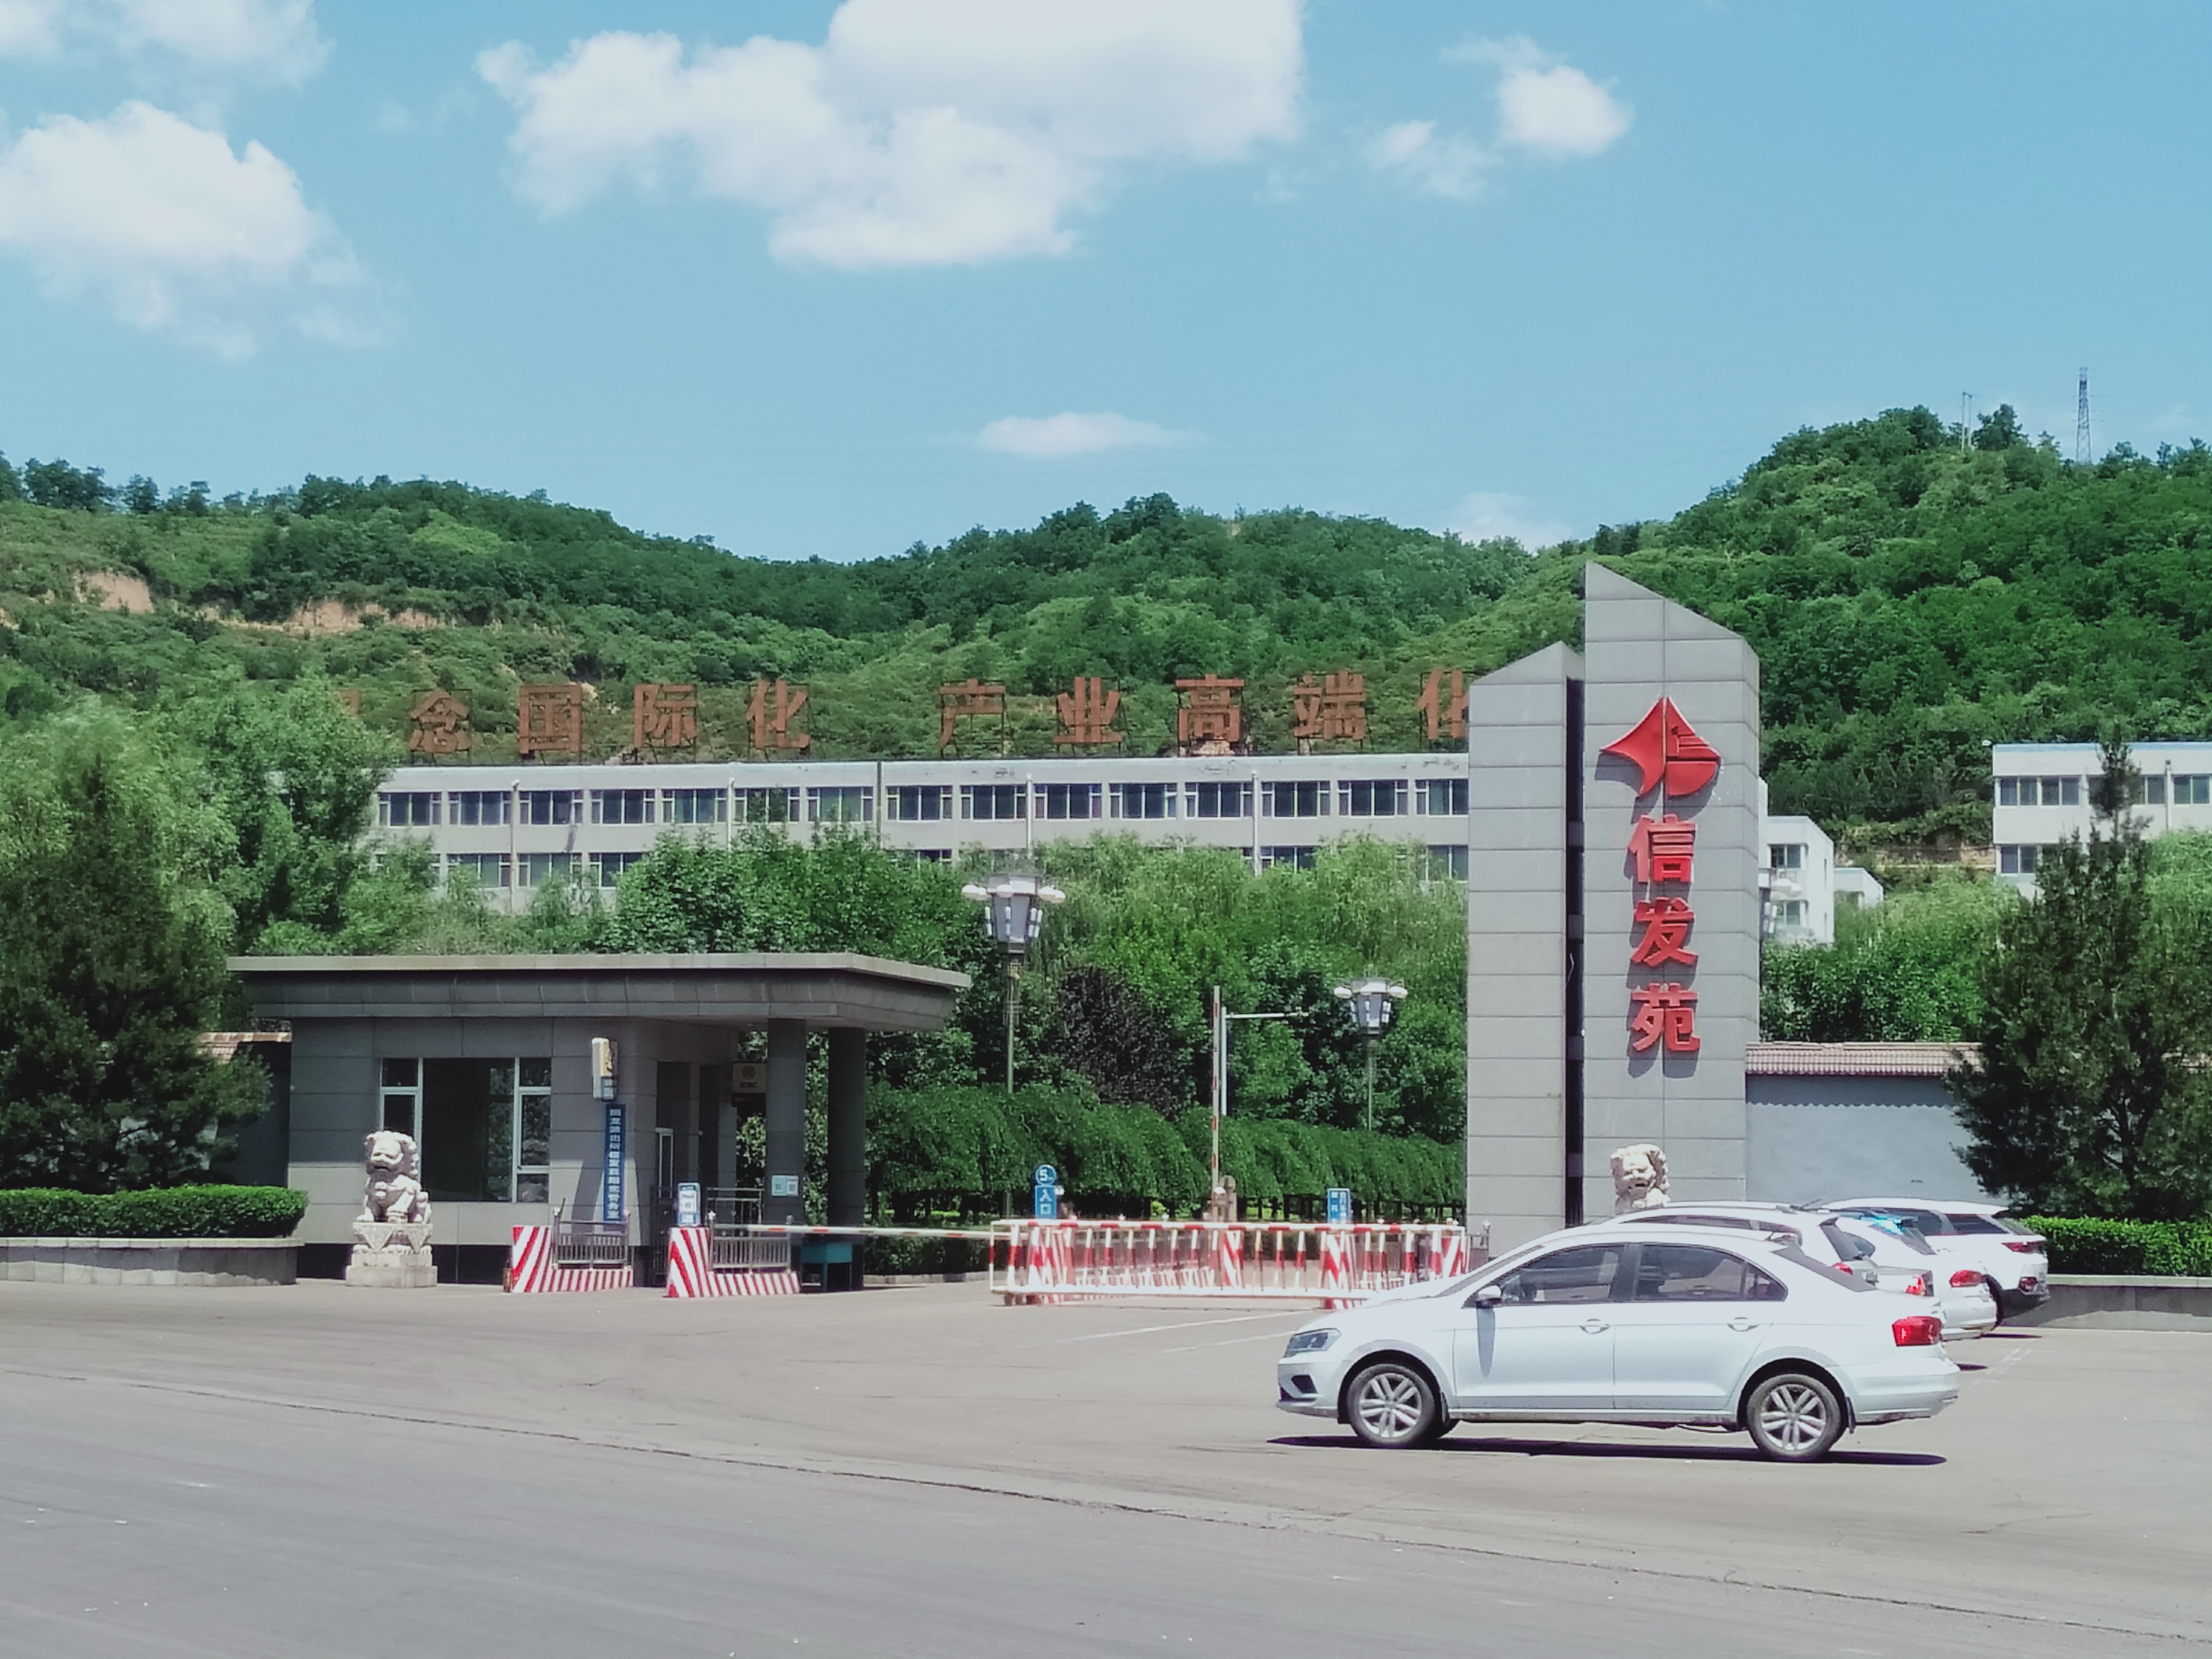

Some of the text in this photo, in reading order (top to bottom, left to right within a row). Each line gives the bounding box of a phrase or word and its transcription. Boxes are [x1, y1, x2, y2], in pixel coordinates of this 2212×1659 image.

[338, 680, 810, 752] 念国际化
[1627, 814, 1701, 1052] 信发苑
[1039, 1188, 1052, 1215] 入口
